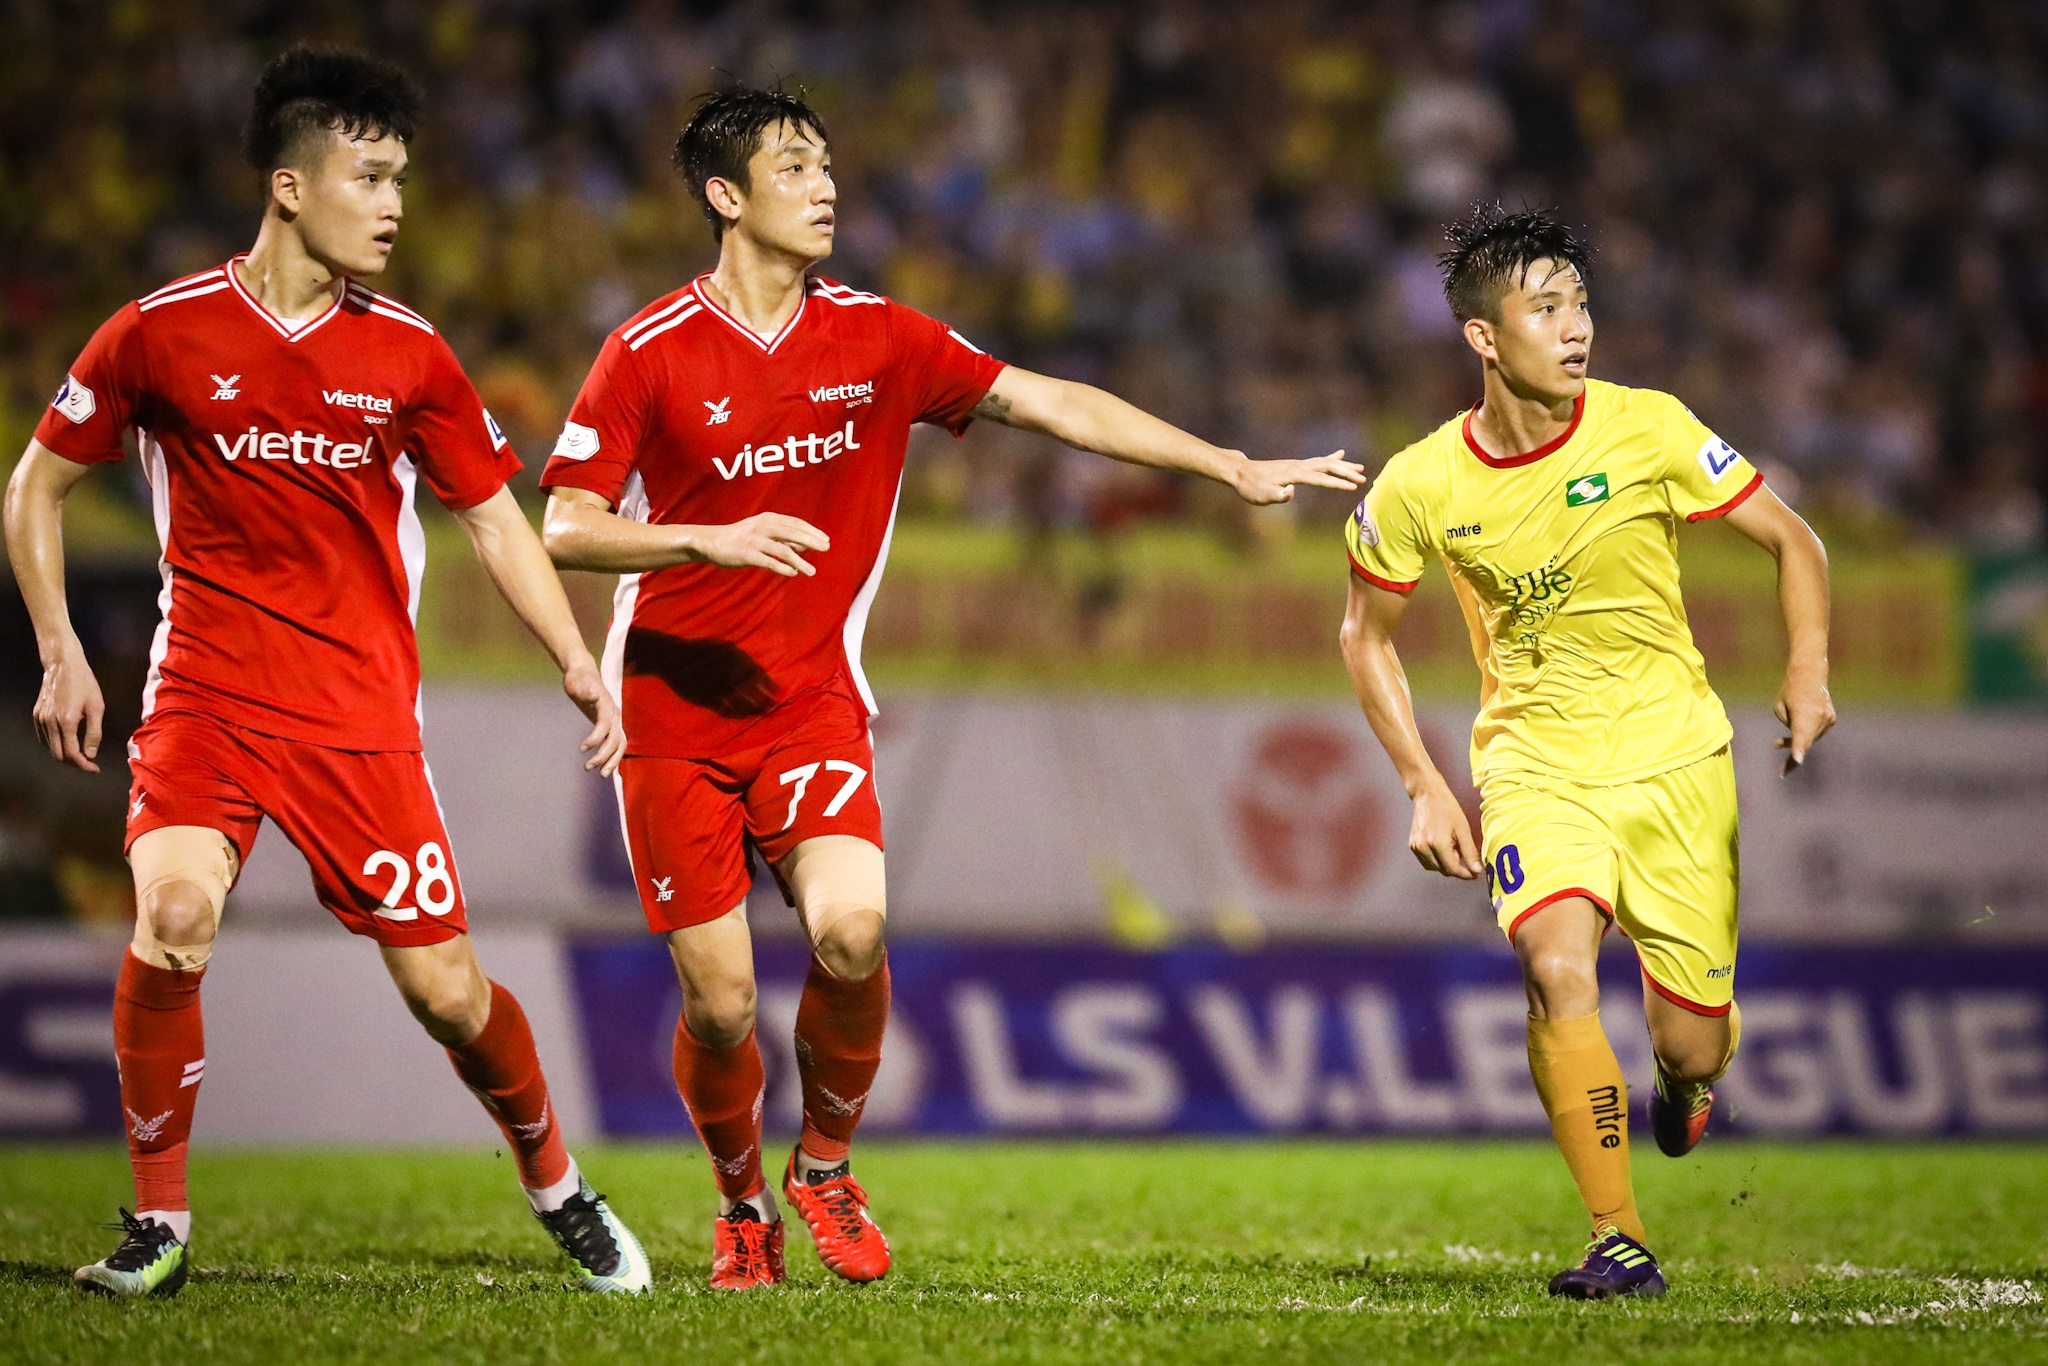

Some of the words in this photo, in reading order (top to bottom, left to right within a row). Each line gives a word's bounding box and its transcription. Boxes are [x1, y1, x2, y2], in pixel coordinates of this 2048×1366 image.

[322, 389, 393, 413] viettel
[809, 380, 874, 403] viettel
[213, 426, 374, 470] viettel
[711, 420, 861, 481] viettel
[1446, 524, 1482, 539] mitre
[779, 760, 868, 831] 77
[362, 841, 455, 921] 28
[949, 982, 1182, 1127] LS
[1587, 1085, 1626, 1149] mitre
